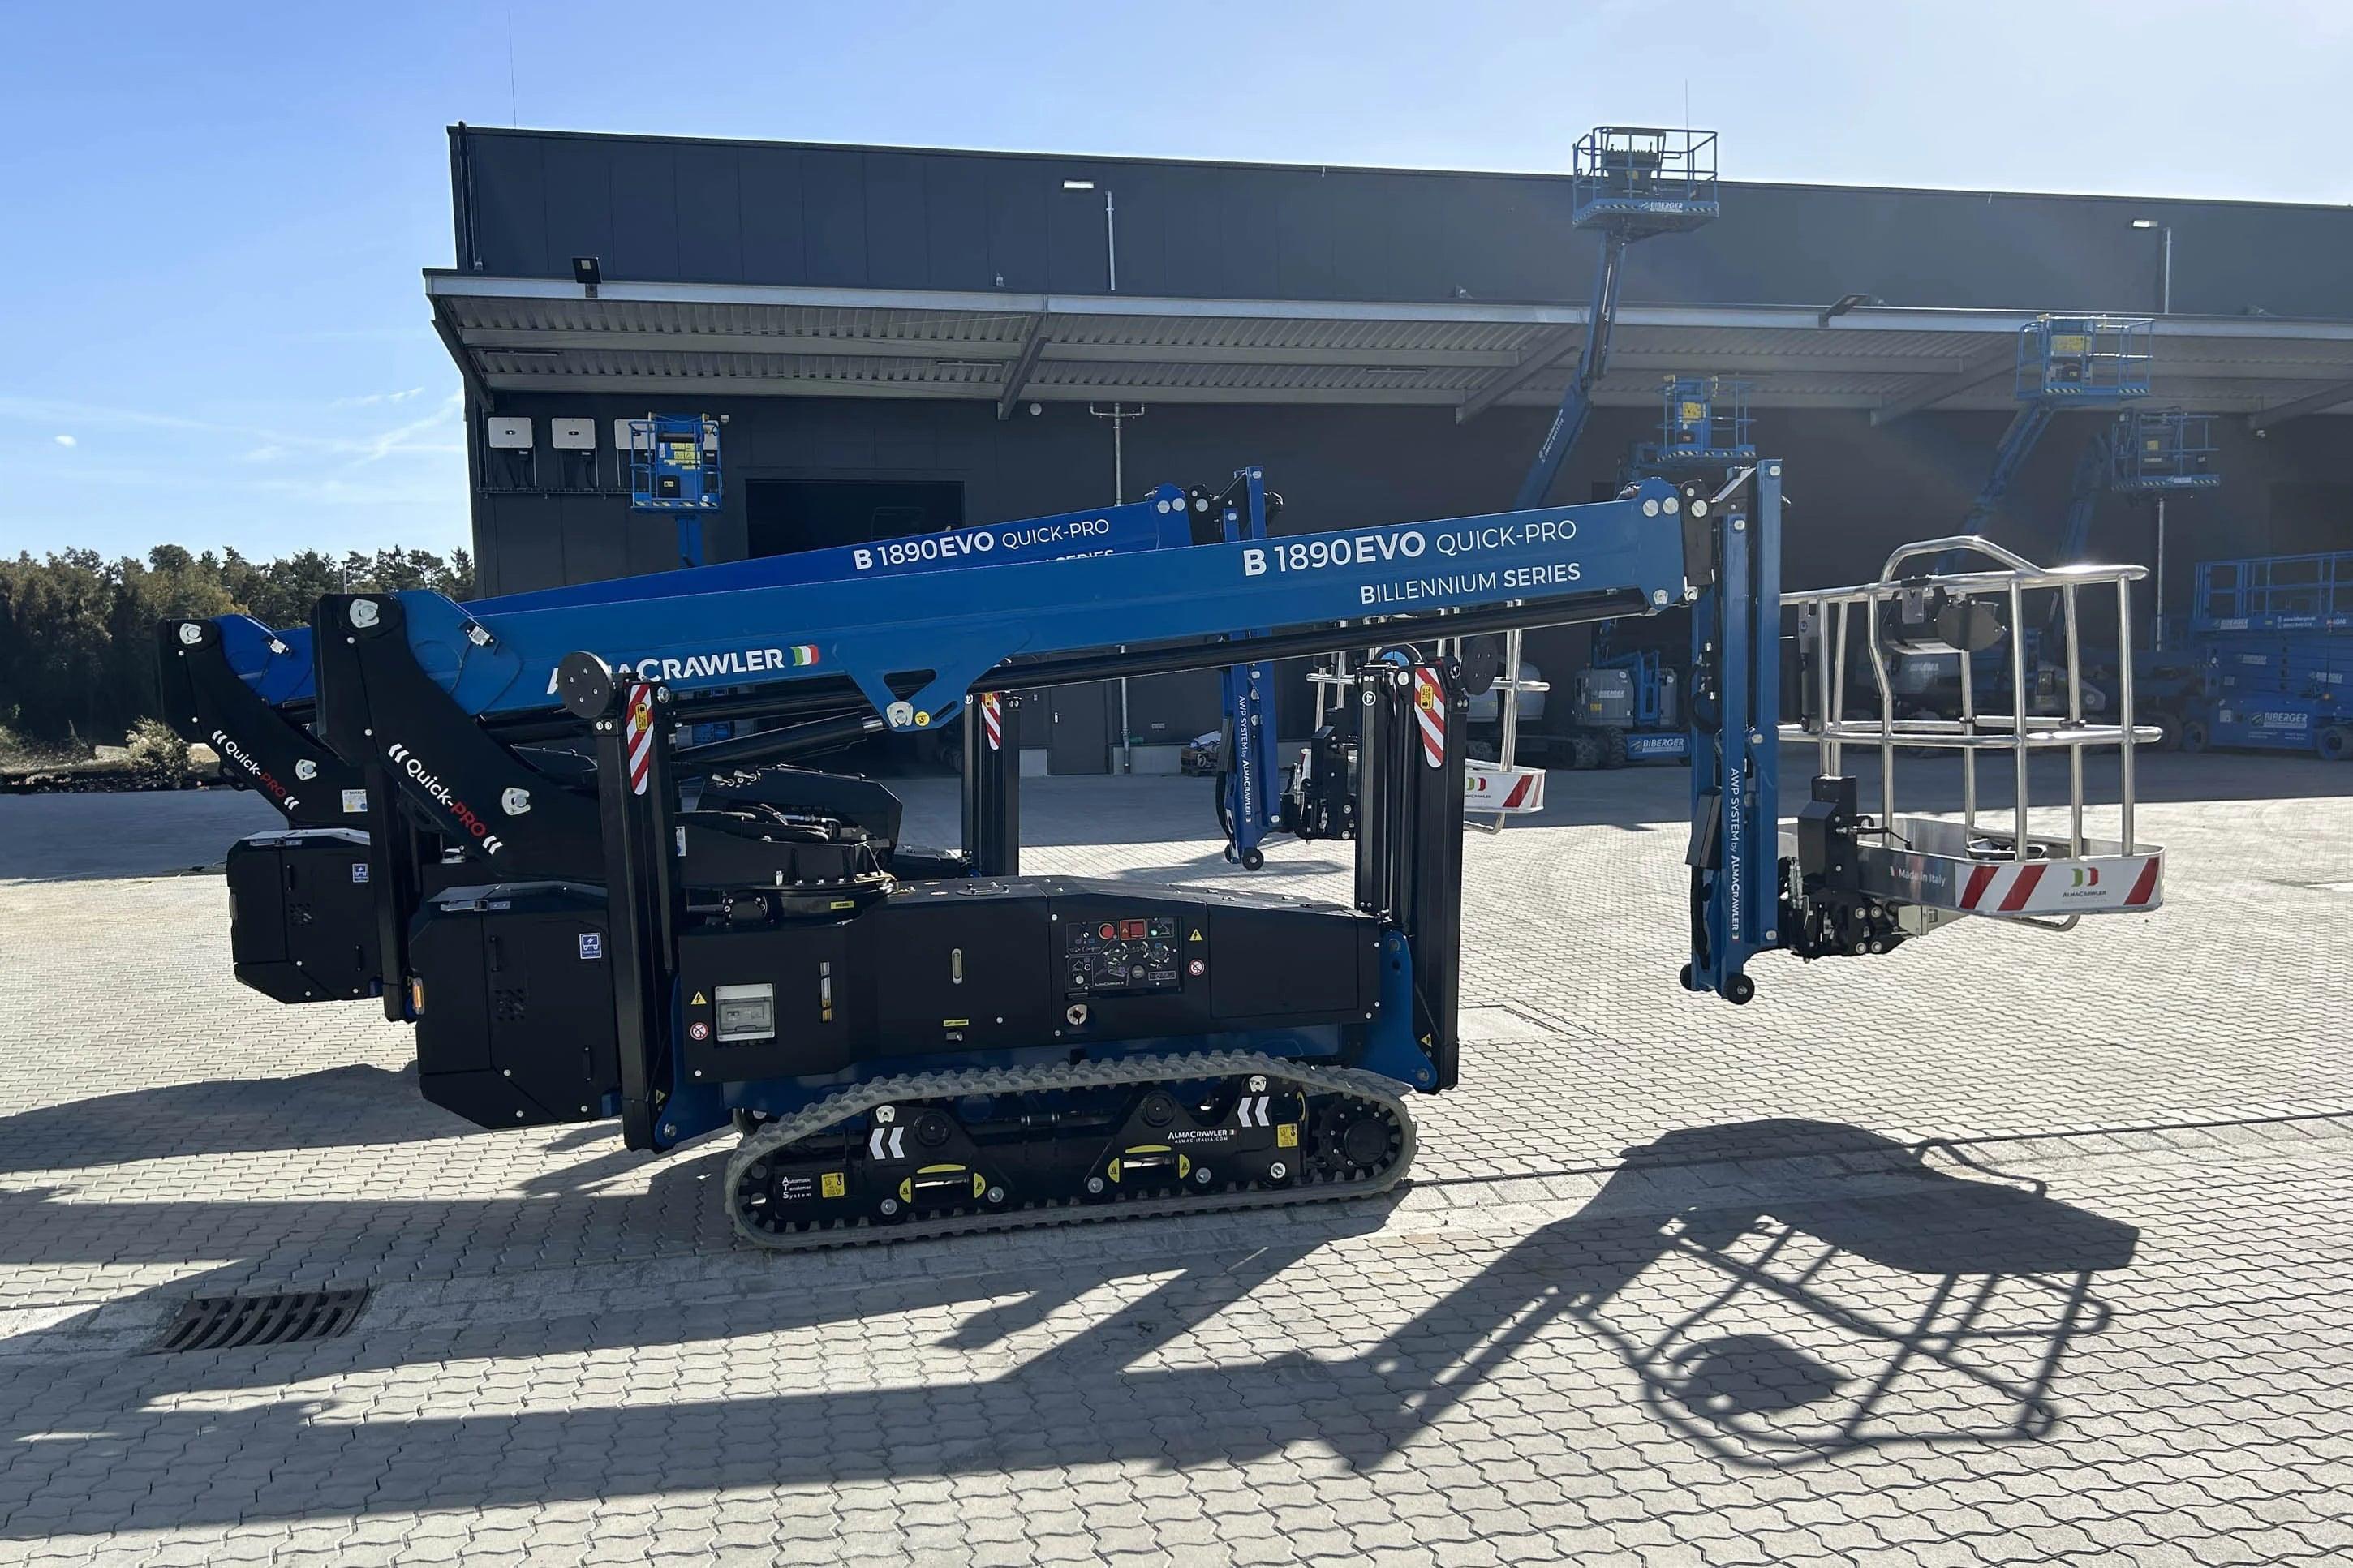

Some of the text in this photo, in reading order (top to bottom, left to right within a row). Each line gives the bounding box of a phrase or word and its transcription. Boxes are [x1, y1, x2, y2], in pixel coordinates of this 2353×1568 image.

[854, 519, 1109, 570] B 1890EVO QUICK-PRO
[1242, 519, 1577, 576] B 1890EVO QUICK-PRO
[1360, 562, 1581, 604] BILLENNIUM SERIES
[226, 741, 286, 797] Quick-PRO
[1238, 695, 1251, 815] AWP SYSTEM by ALMACRAWLER
[1643, 738, 1684, 747] BIBERGER
[407, 759, 486, 836] Quick-PRO
[1731, 767, 1740, 931] AWP SYSTEM by ALMACRAWLER
[1929, 874, 1946, 887] Italy
[1168, 1129, 1228, 1140] ALMACRAWLER
